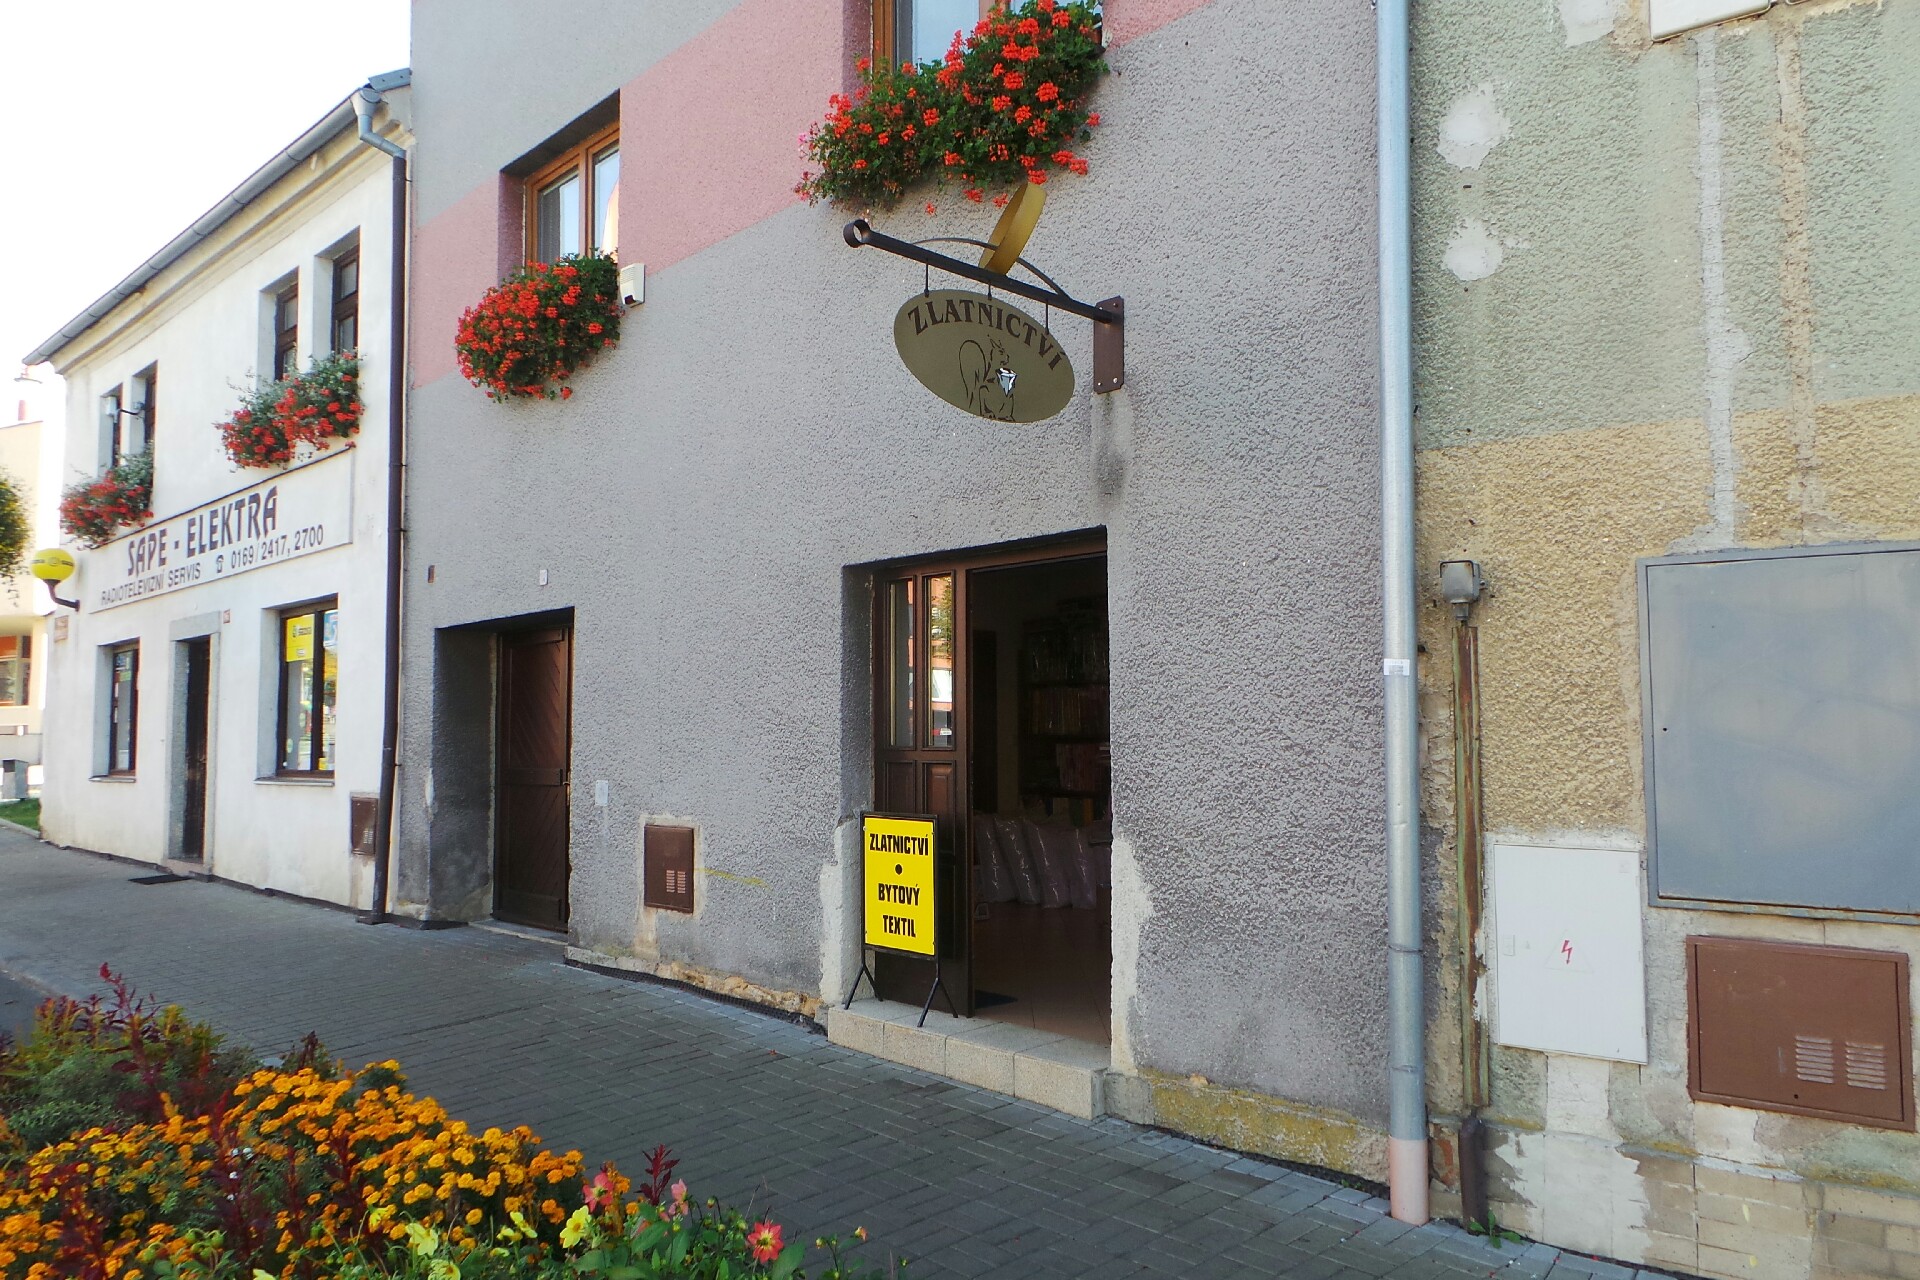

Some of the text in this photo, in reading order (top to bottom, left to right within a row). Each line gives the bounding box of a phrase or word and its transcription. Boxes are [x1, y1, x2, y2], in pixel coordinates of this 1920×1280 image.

[907, 299, 1068, 371] ZLATNICTVÍ
[128, 528, 167, 577] SAPE
[187, 485, 278, 558] ELEKTRA
[294, 524, 324, 551] 2700
[100, 562, 201, 605] RADIOTELEVIZNÍ SERVIS
[869, 833, 929, 856] ZLATNICTVÍ
[878, 883, 920, 906] BYTOVÝ
[882, 915, 916, 938] TEXTIL
